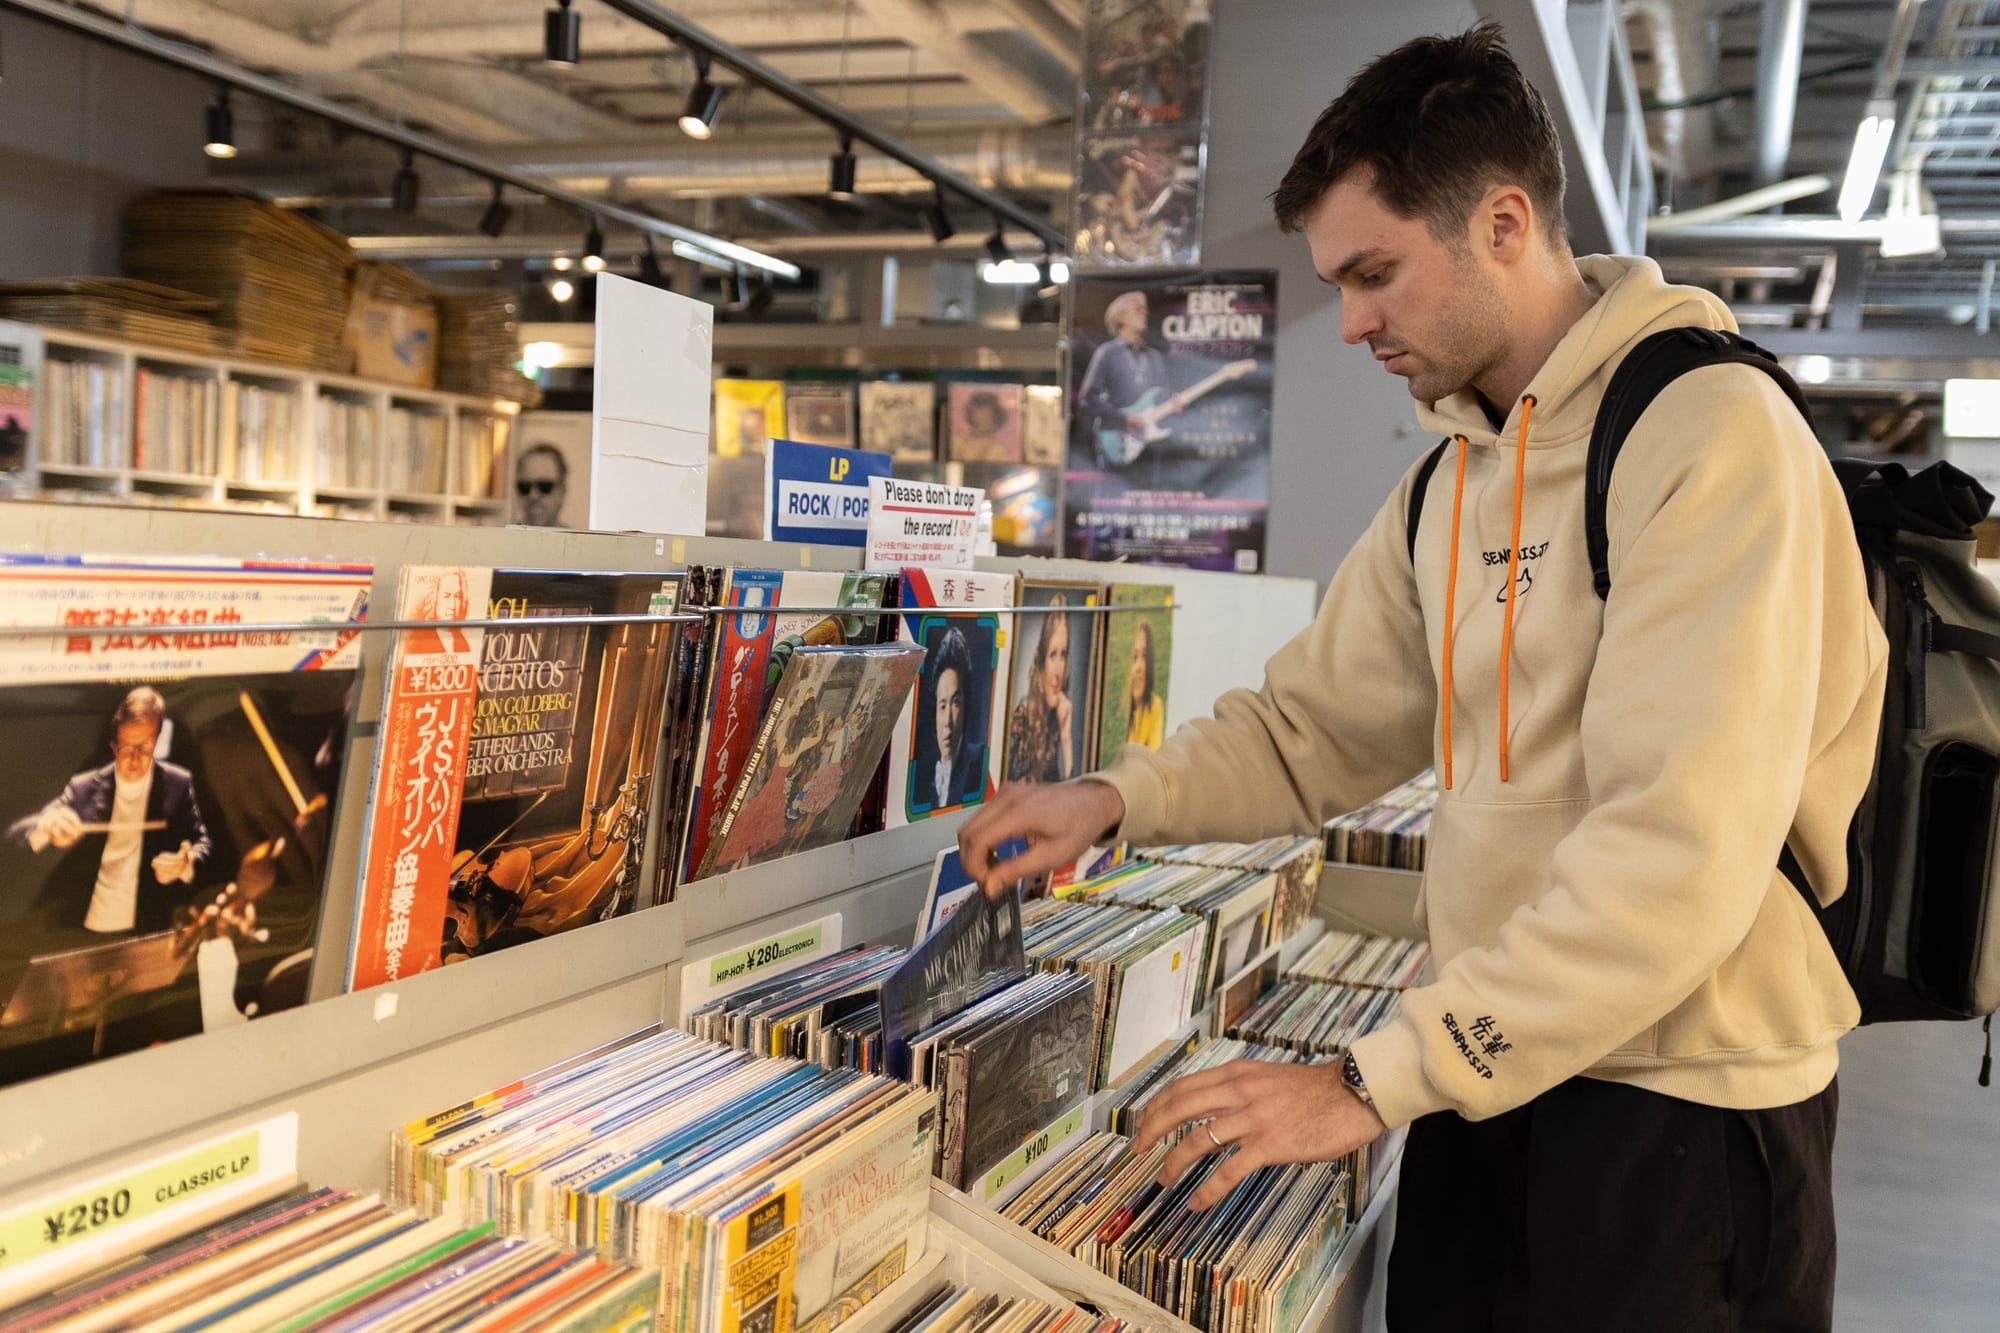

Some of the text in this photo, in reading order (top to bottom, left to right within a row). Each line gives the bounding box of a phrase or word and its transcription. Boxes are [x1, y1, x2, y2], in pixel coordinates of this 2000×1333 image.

[1186, 290, 1237, 314] ERIC
[1161, 314, 1263, 340] CLAPTON
[829, 456, 849, 481] LP
[788, 492, 830, 516] ROCK
[885, 480, 975, 512] Please don't drop
[904, 516, 920, 535] the
[921, 519, 953, 537] record
[1482, 541, 1549, 566] SENIS.J
[64, 605, 241, 655] 管弦楽組曲
[410, 664, 468, 691] ¥1,300
[505, 692, 572, 714] GOLDBERG
[772, 698, 785, 715] THE
[483, 713, 541, 735] MAGYAR
[757, 714, 778, 752] JOURNEY
[494, 747, 572, 774] ORCHESTRA
[730, 775, 752, 813] POPULAR
[719, 814, 736, 838] MUSIC
[716, 938, 815, 982] HIP-HOP ¥280 ELECTRONICA
[1442, 1012, 1493, 1079] SENPAIS.JP
[996, 1123, 1072, 1189] LP ¥100 LP
[43, 1155, 250, 1243] ¥280 CLASSIC LP
